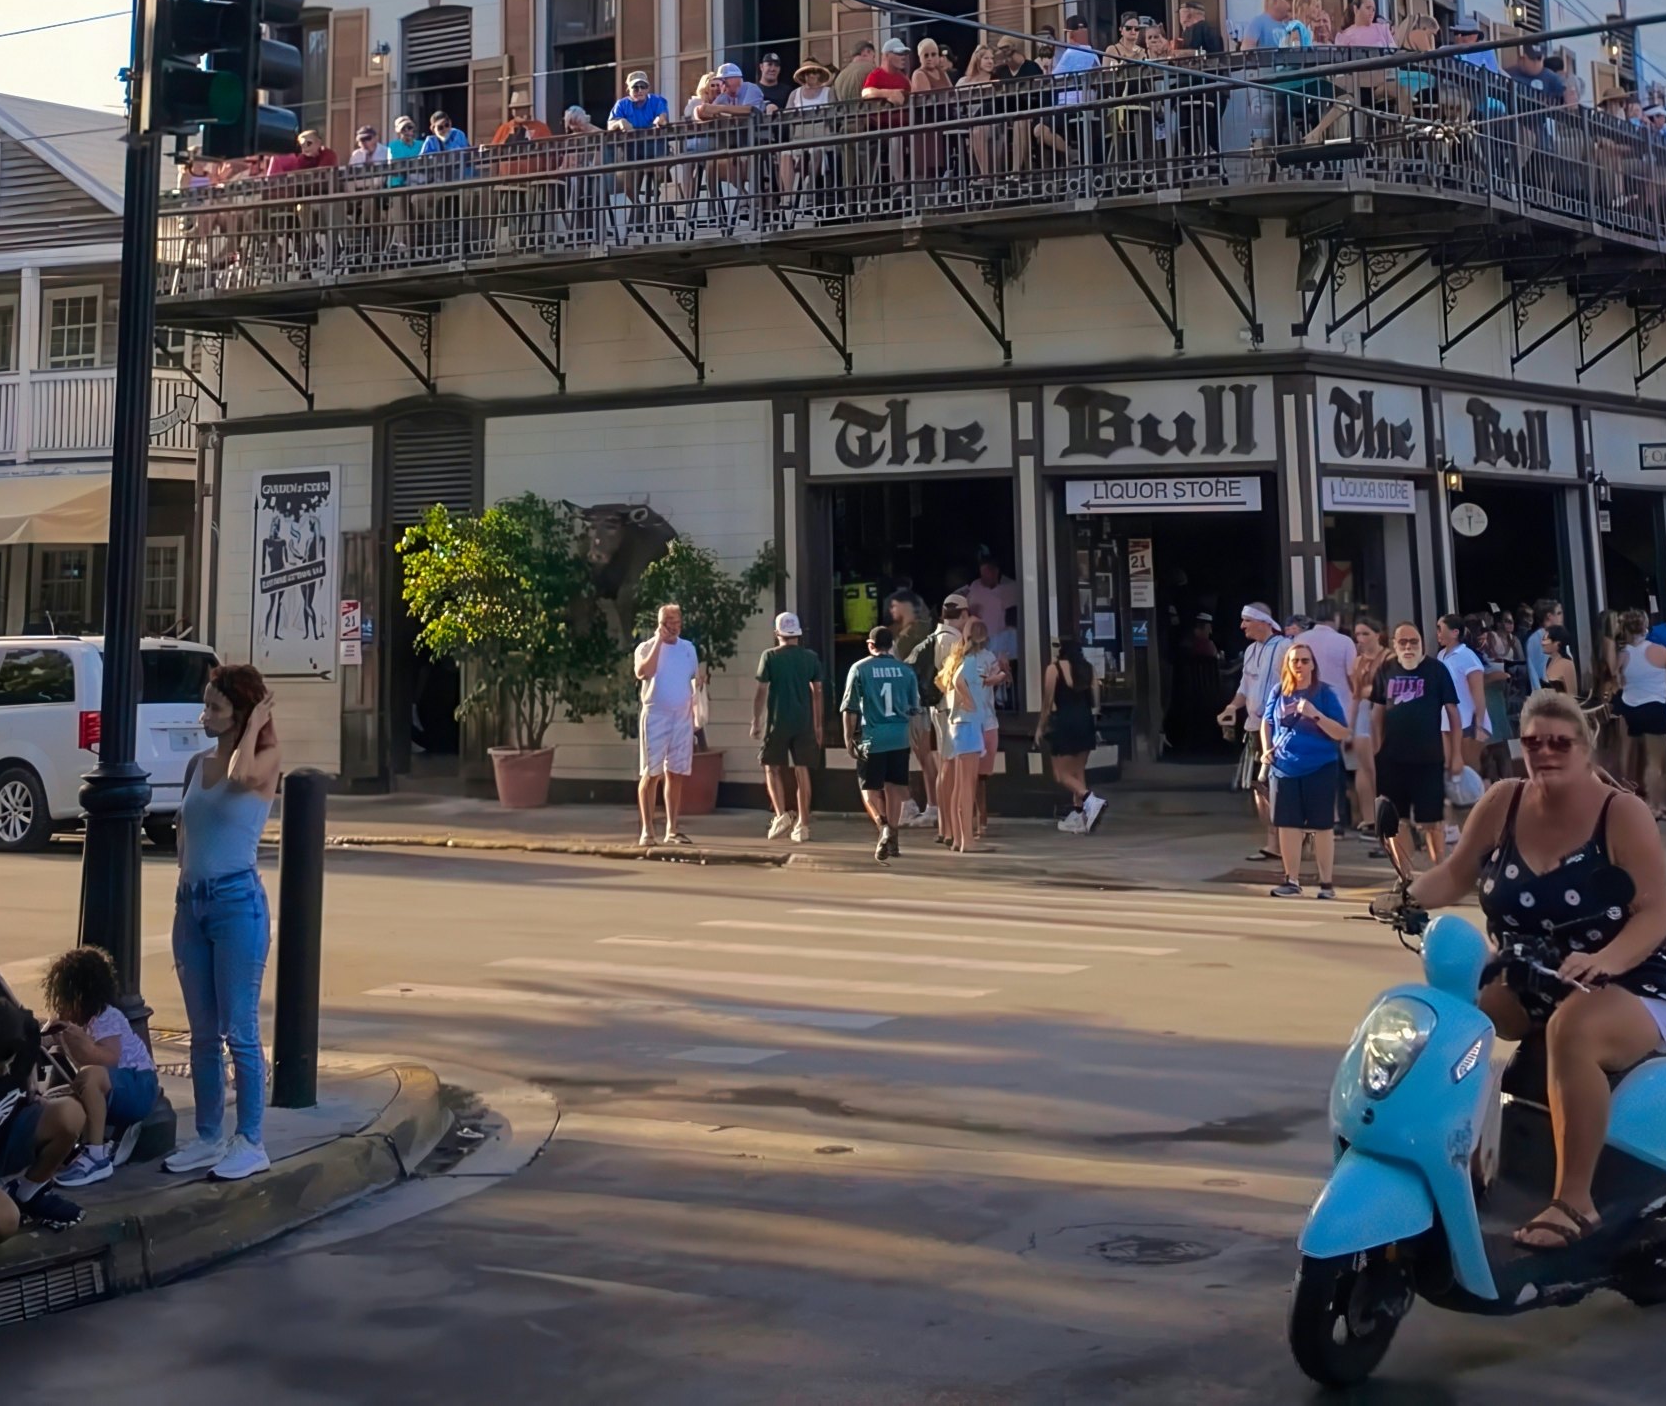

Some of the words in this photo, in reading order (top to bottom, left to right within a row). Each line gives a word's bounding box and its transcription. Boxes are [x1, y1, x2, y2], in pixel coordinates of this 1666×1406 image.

[830, 398, 989, 470] The
[1053, 384, 1259, 459] Bull
[1328, 385, 1417, 461] The
[1466, 396, 1552, 473] Bull
[1093, 481, 1168, 500] LIQUOR
[1173, 479, 1242, 499] STORE
[1130, 555, 1147, 569] 21
[344, 615, 357, 628] 21
[880, 682, 897, 717] 1
